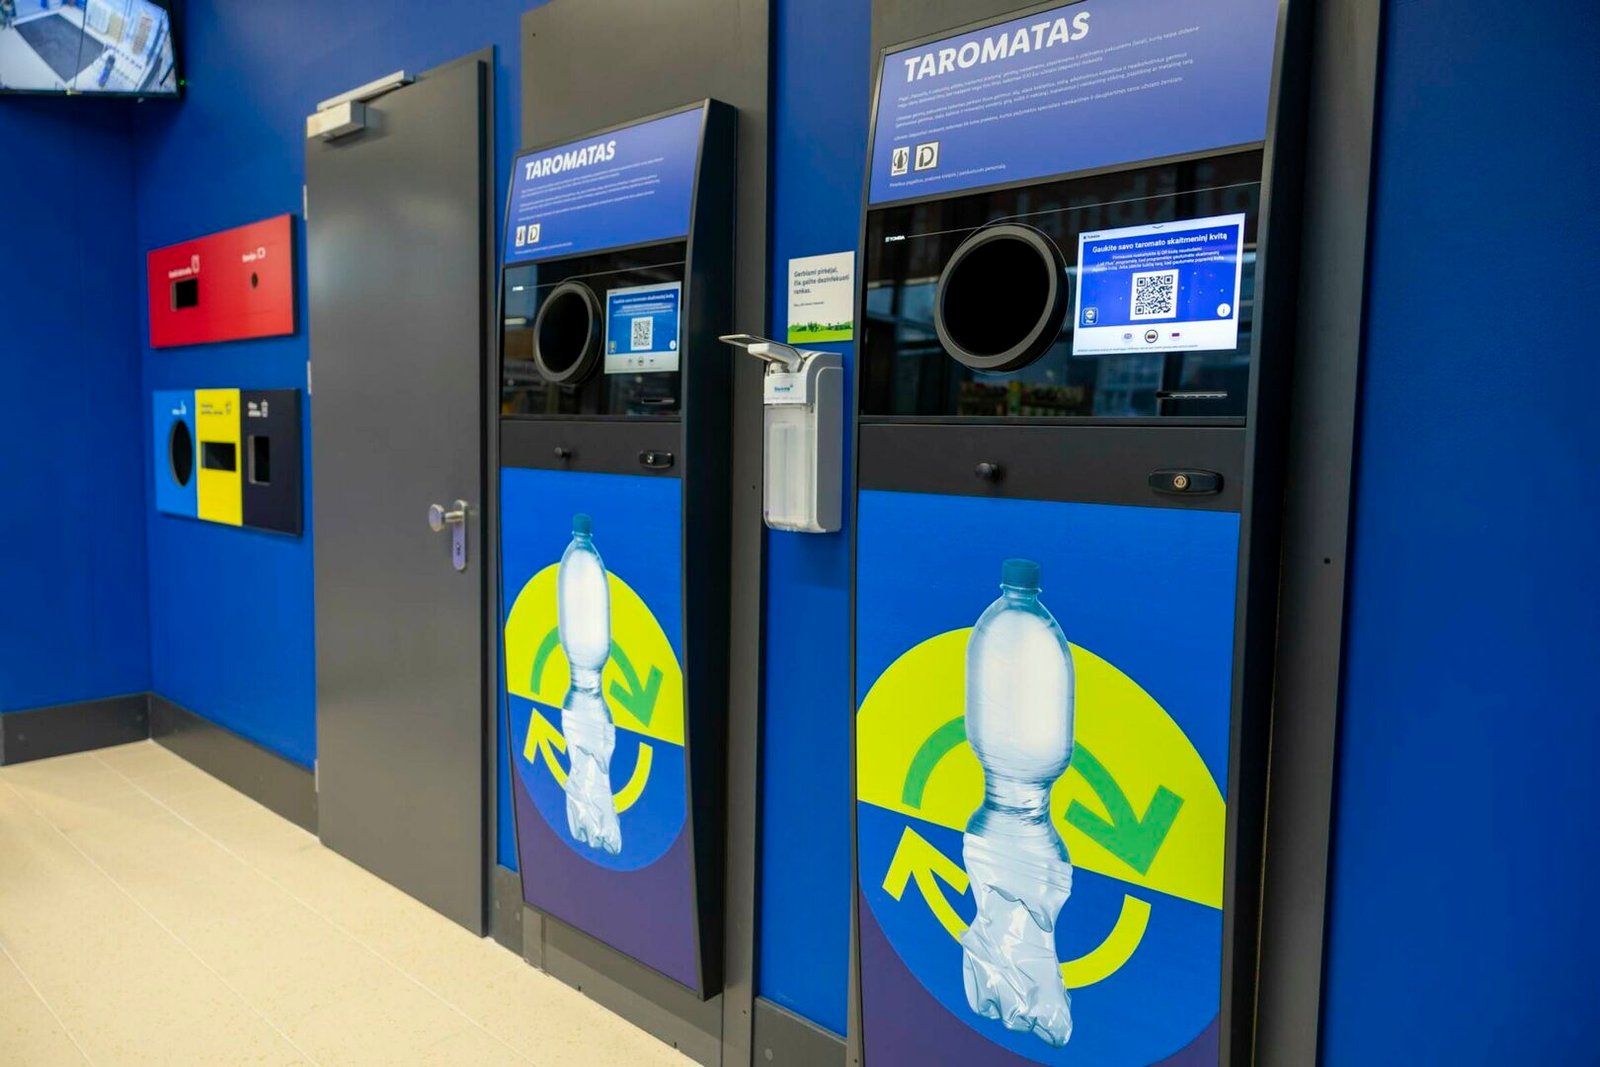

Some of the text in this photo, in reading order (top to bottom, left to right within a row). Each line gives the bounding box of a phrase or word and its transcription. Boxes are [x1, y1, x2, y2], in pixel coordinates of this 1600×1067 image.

[904, 11, 1091, 83] TAROMATAS
[525, 140, 617, 181] TAROMATAS
[1118, 243, 1134, 251] savo
[1135, 240, 1166, 249] taromato
[1167, 234, 1208, 244] skaitmeninį
[1209, 232, 1228, 241] kvitą
